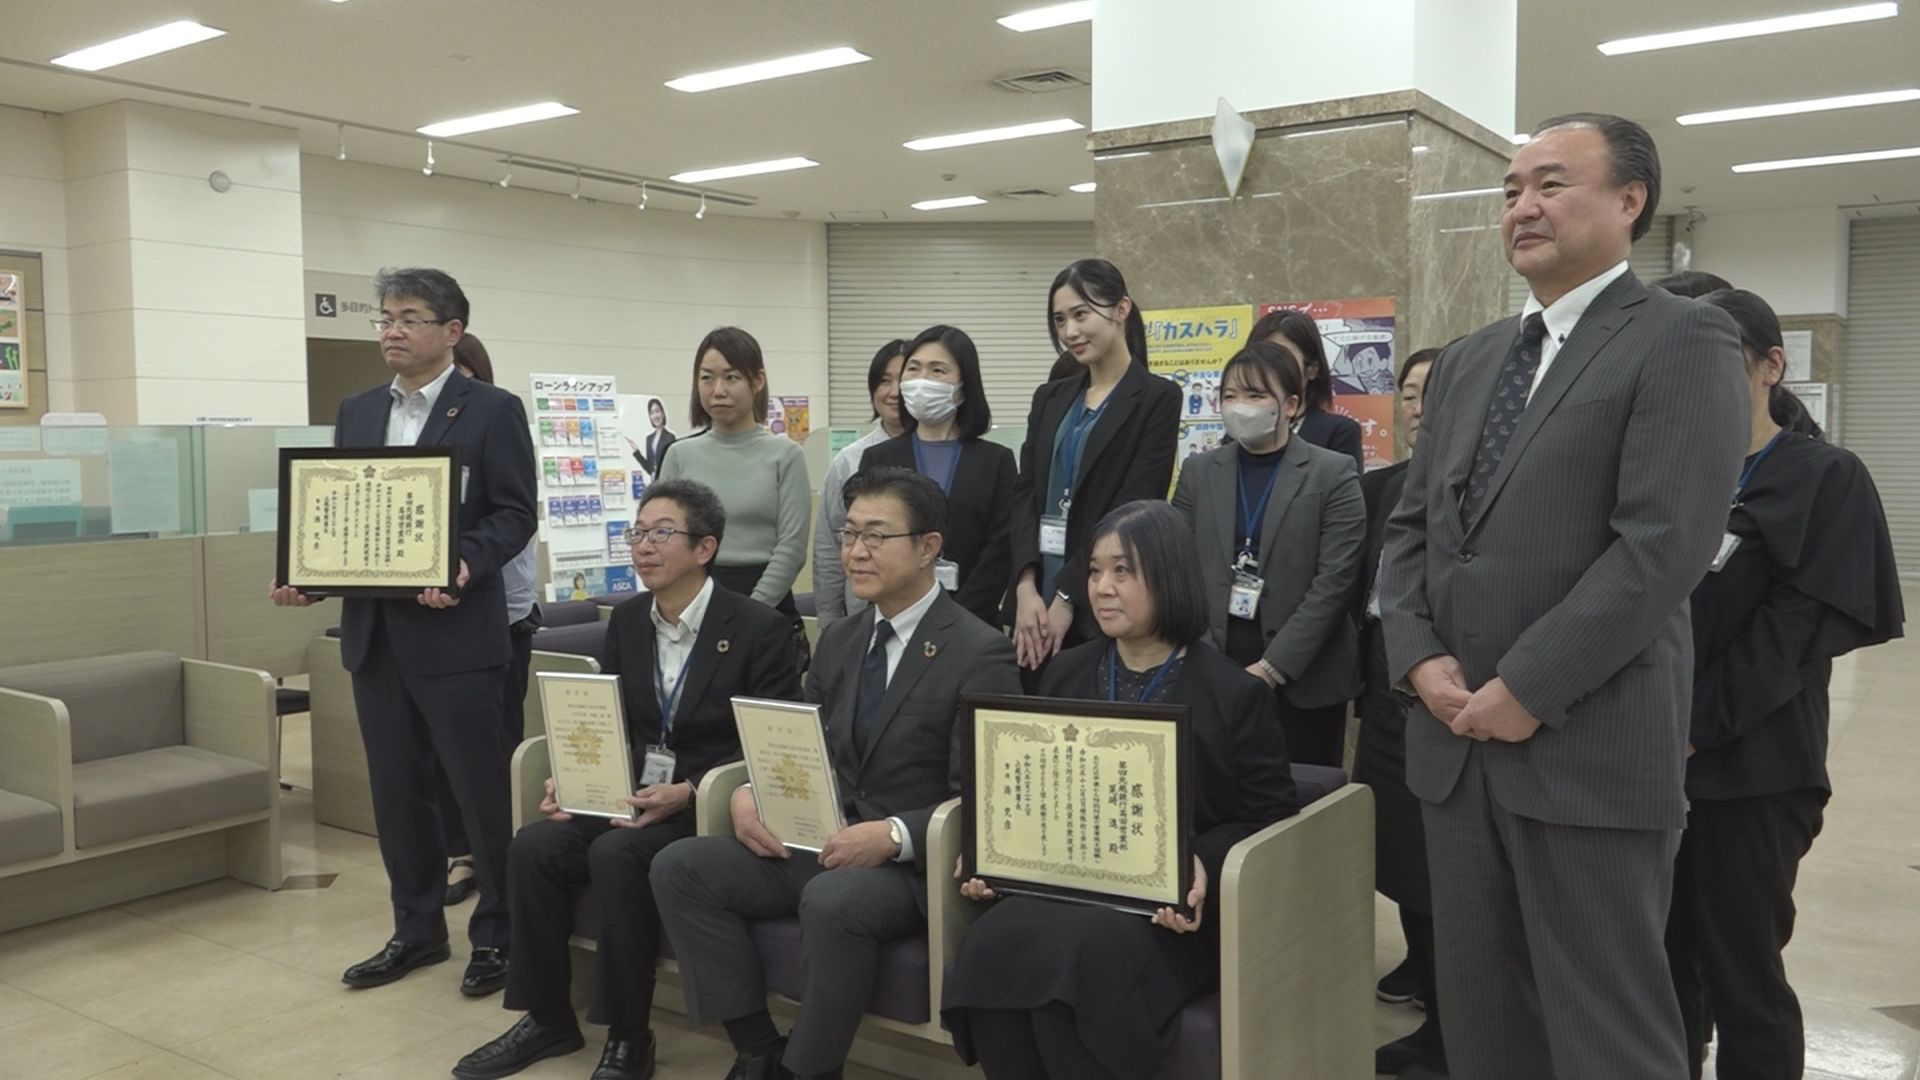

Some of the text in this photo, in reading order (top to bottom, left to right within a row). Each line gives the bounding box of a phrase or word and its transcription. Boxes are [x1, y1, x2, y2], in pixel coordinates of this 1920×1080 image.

[415, 504, 425, 542] 感謝状
[1131, 783, 1143, 836] 感謝状
